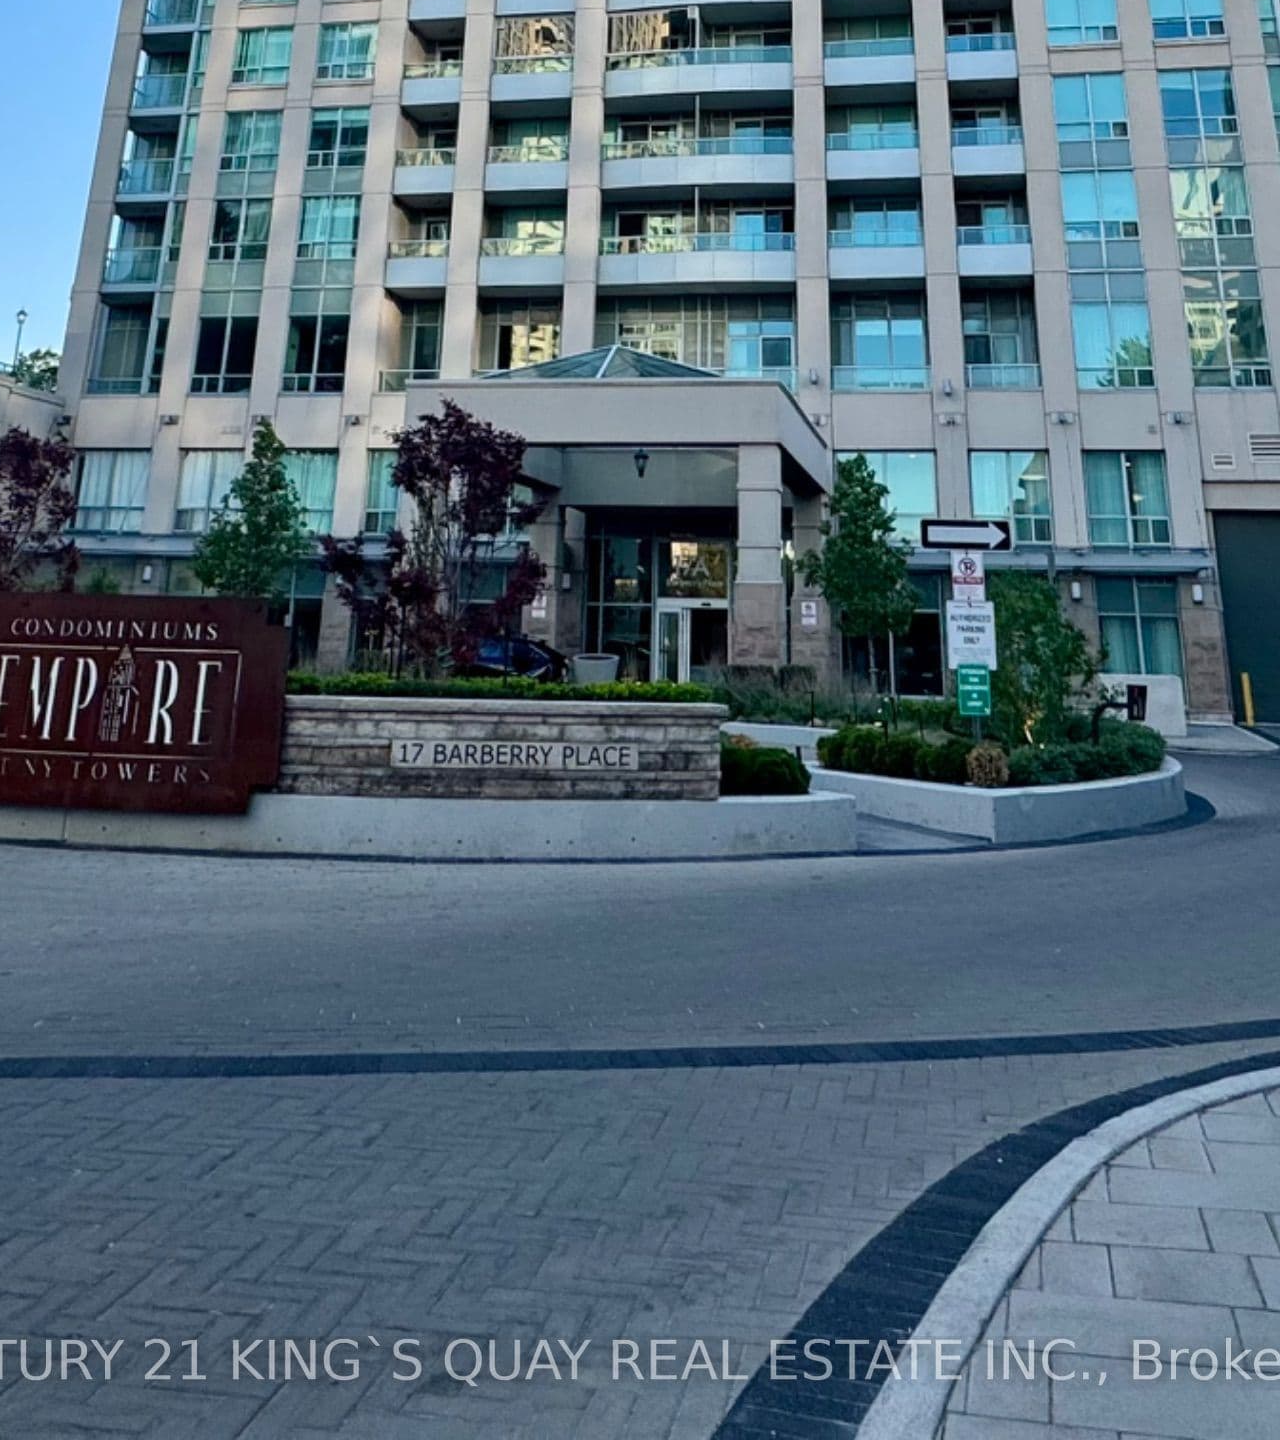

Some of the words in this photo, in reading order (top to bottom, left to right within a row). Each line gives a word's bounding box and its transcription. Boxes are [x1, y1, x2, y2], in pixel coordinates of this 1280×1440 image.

[10, 617, 219, 641] CONDOMINIUMS
[398, 744, 422, 764] 17
[432, 744, 553, 767] BARBERRY
[562, 746, 631, 768] PLACE
[71, 759, 210, 783] TOWERS
